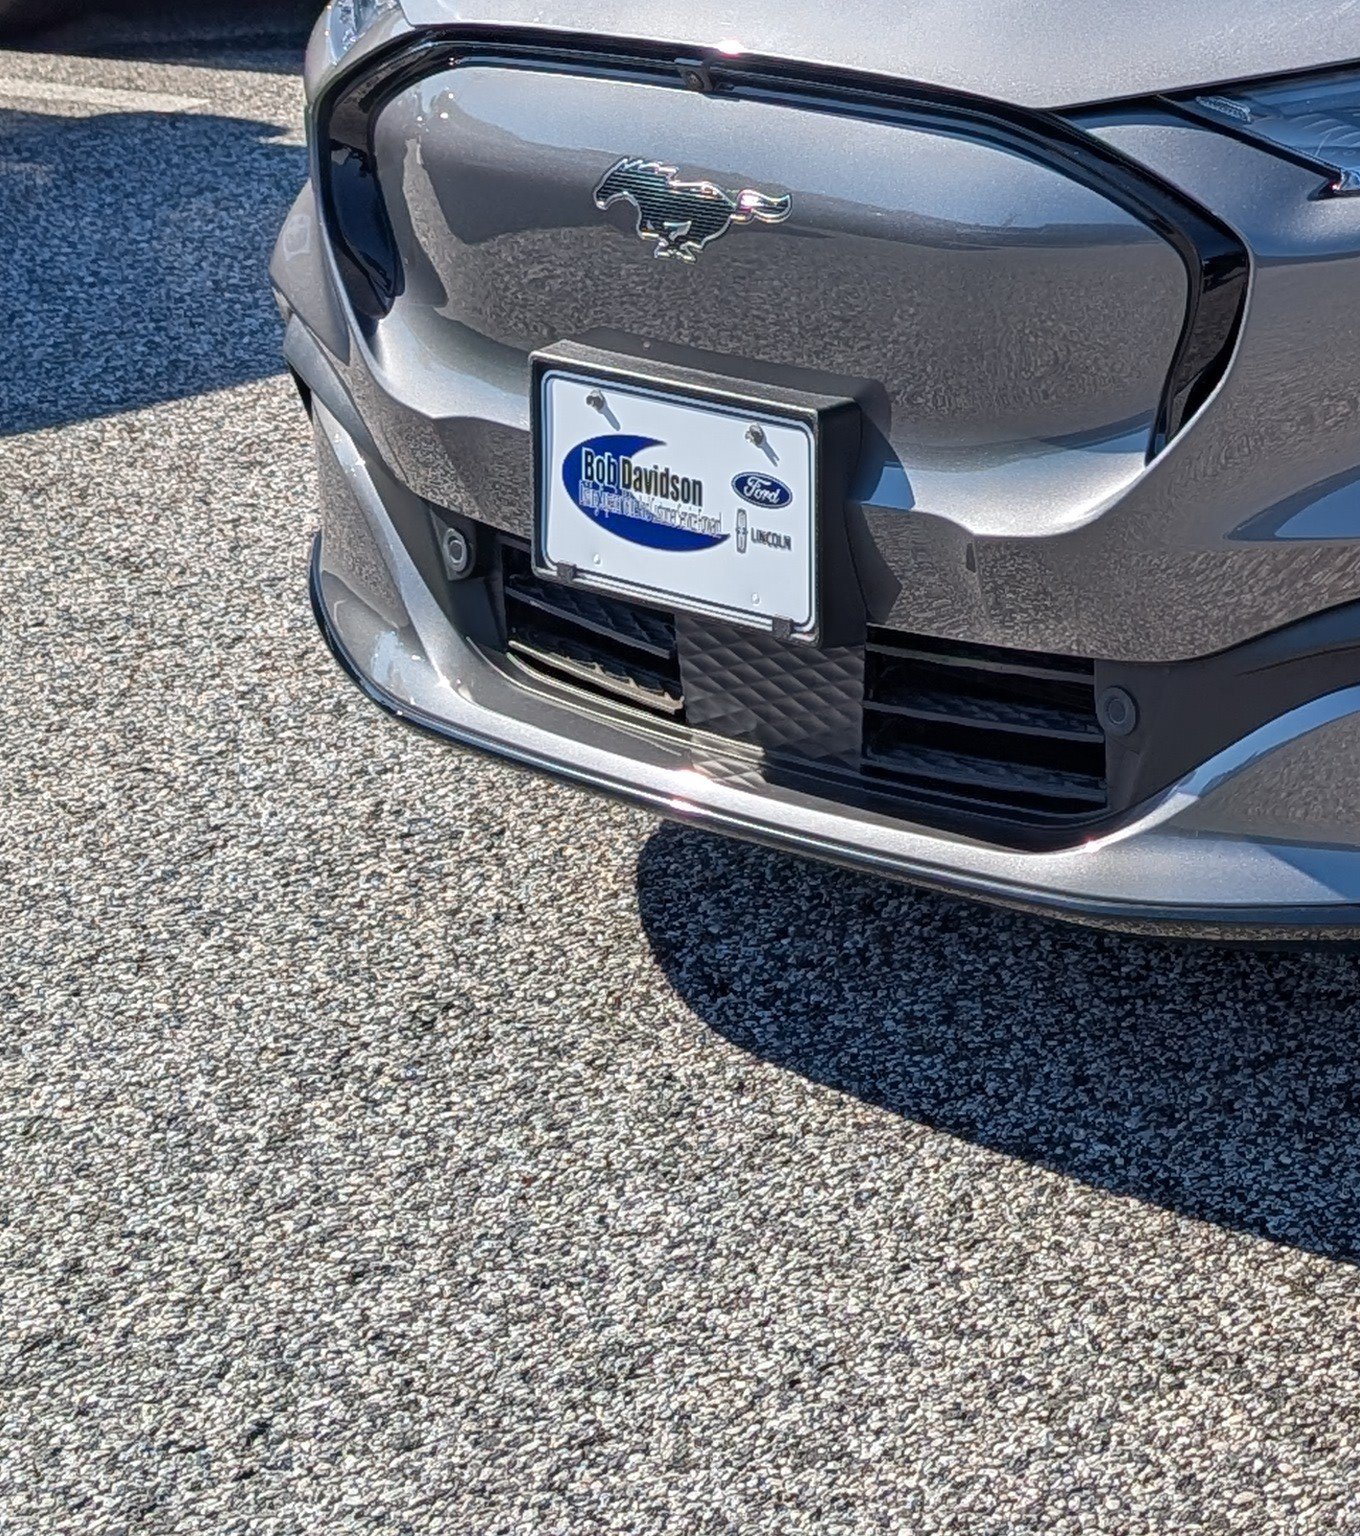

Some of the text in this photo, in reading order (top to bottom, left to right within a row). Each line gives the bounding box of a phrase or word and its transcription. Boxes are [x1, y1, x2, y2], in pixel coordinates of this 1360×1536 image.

[583, 448, 704, 507] Bob Davidson
[743, 475, 782, 504] Ford
[750, 527, 792, 551] LINCOLN
